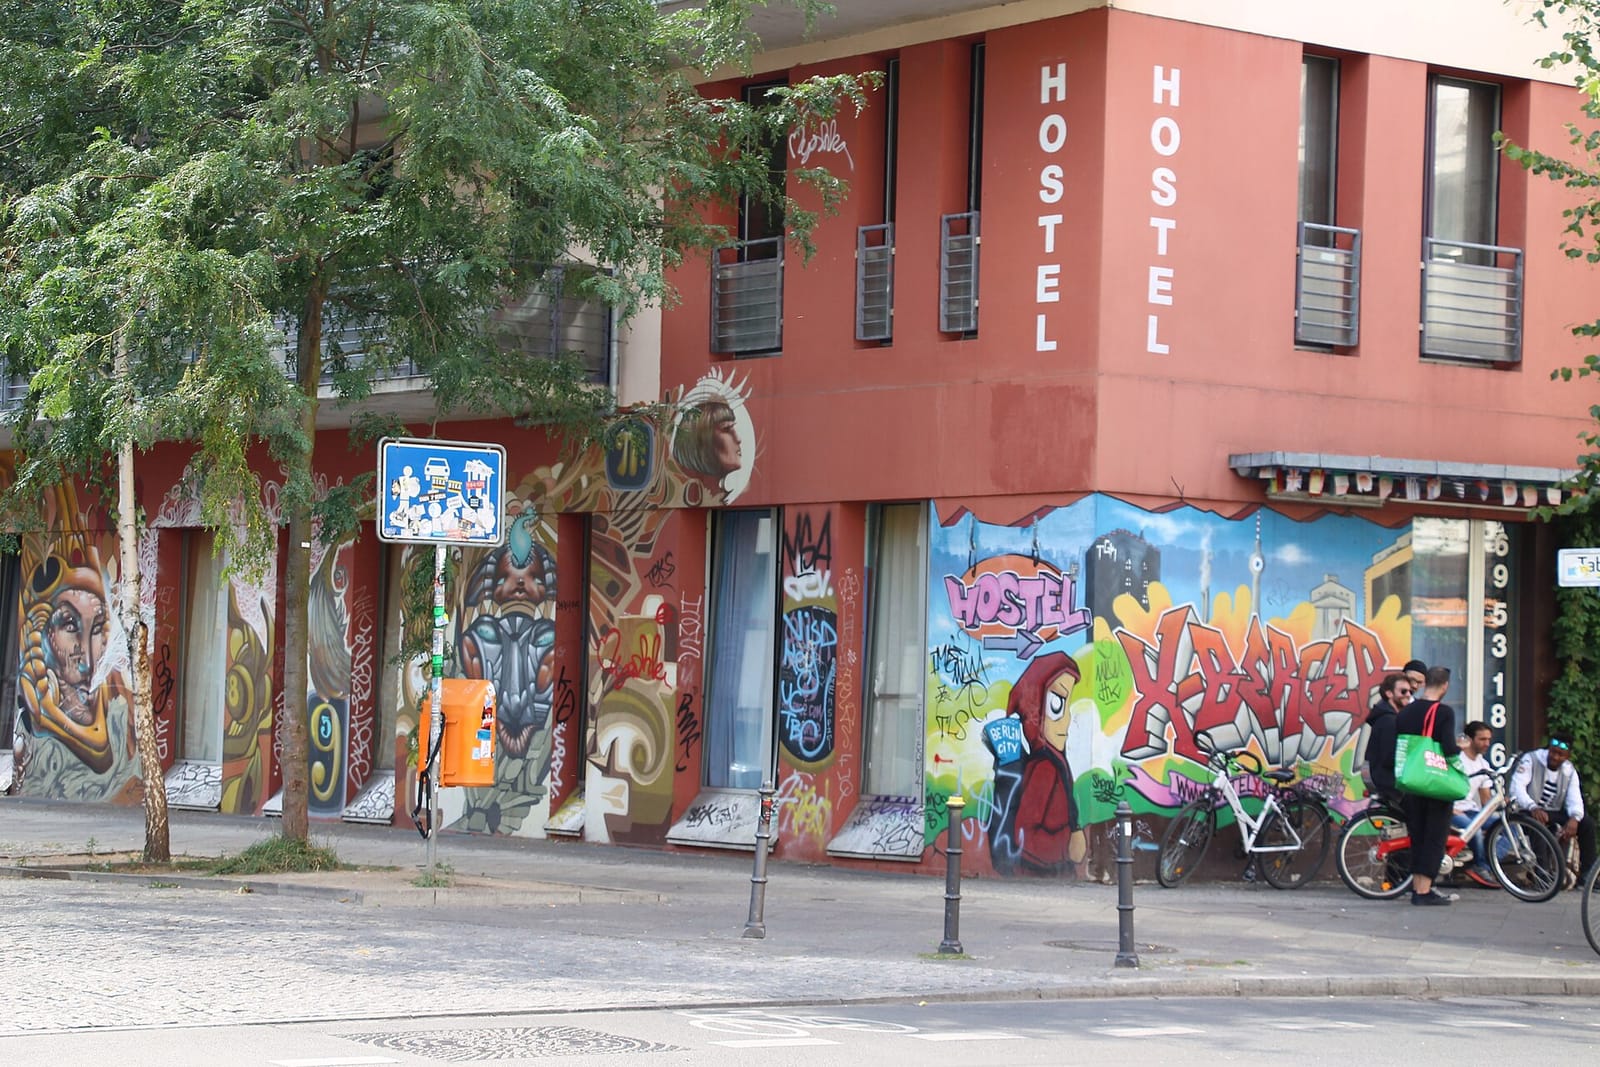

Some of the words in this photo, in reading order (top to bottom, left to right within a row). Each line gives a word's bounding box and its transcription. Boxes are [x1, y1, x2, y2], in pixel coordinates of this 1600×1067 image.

[1036, 62, 1067, 352] HOSTEL
[1147, 65, 1181, 354] HOSTEL
[944, 571, 1093, 636] HOSTEL
